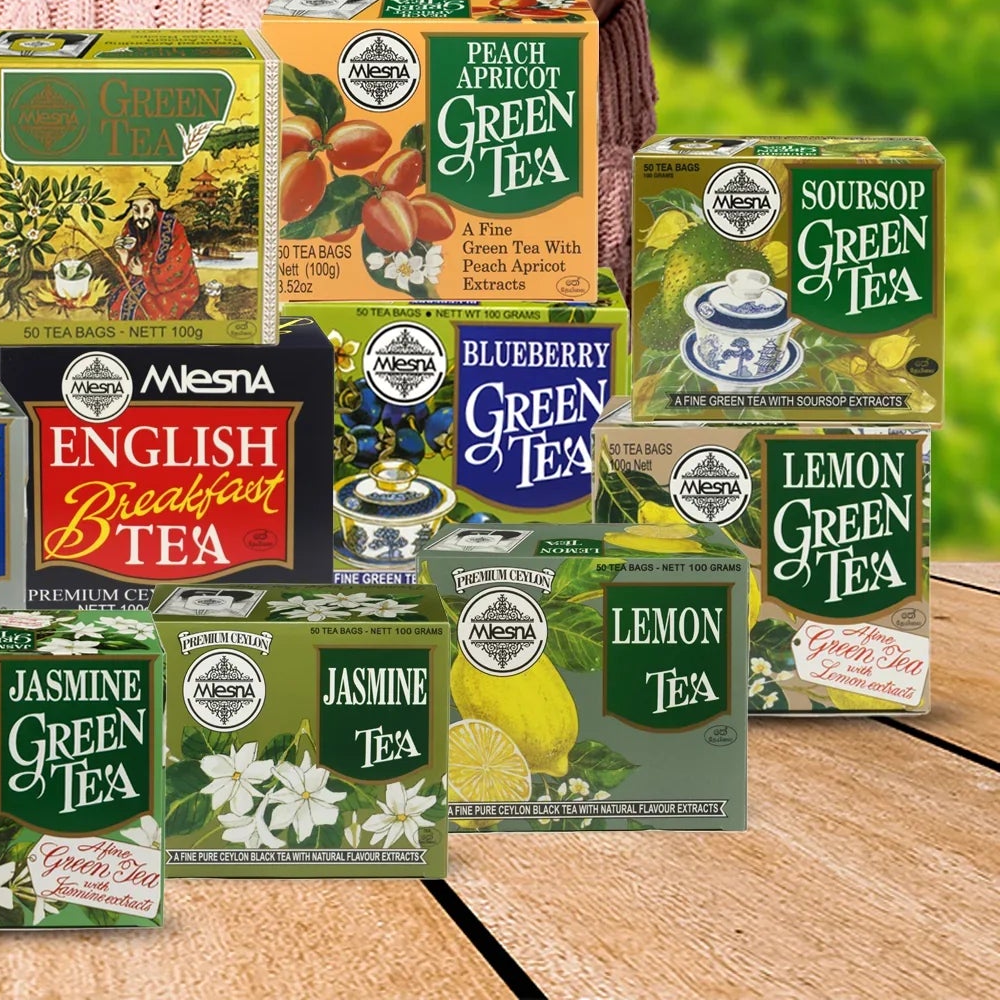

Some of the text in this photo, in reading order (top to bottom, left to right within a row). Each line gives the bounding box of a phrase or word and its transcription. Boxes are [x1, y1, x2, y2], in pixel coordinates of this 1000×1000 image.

[467, 42, 546, 64] PEACH
[457, 67, 560, 89] APRICOT
[100, 79, 222, 118] GREEN
[101, 119, 176, 156] TEA
[437, 89, 575, 182] GREEN
[480, 142, 570, 198] TEA
[644, 164, 700, 172] 50 TEA BAGS
[802, 180, 924, 210] SOURSOP
[462, 223, 512, 236] A Fine
[462, 241, 582, 254] Green Tea With
[462, 260, 566, 275] Peach Apricot
[798, 214, 928, 301] GREEN
[463, 278, 526, 291] Extracts
[837, 265, 923, 316] TEA
[357, 308, 540, 320] 50 TEA BAGS NETT WT 100 GRAMS
[23, 326, 202, 340] 50 TEA BAGS NETT 100g
[463, 340, 610, 368] BLUEBERRY
[675, 396, 902, 407] A FINE GREEN TEA WITH SOURSOP EXTRACTS
[465, 378, 607, 472] GREEN
[50, 426, 278, 467] ENGLISH
[508, 432, 592, 489] TEA
[610, 444, 672, 455] 50 TEA BAGS
[783, 452, 904, 489] LEMON
[44, 470, 284, 560] Breakfast
[116, 524, 230, 565] TEA
[773, 493, 912, 588] GREEN
[457, 570, 550, 589] PREMIUM CEYLON
[816, 546, 906, 603] TEA
[183, 632, 269, 650] PREMIUM CEYLON
[370, 627, 392, 635] NETT
[396, 627, 412, 635] 100
[414, 627, 443, 636] GRAMS
[612, 608, 722, 644] LEMON
[9, 669, 140, 702] JASMINE
[323, 668, 427, 706] JASMINE
[646, 668, 720, 714] TEA
[8, 707, 146, 799] GREEN
[355, 726, 421, 769] TEA
[50, 758, 140, 814] TEA
